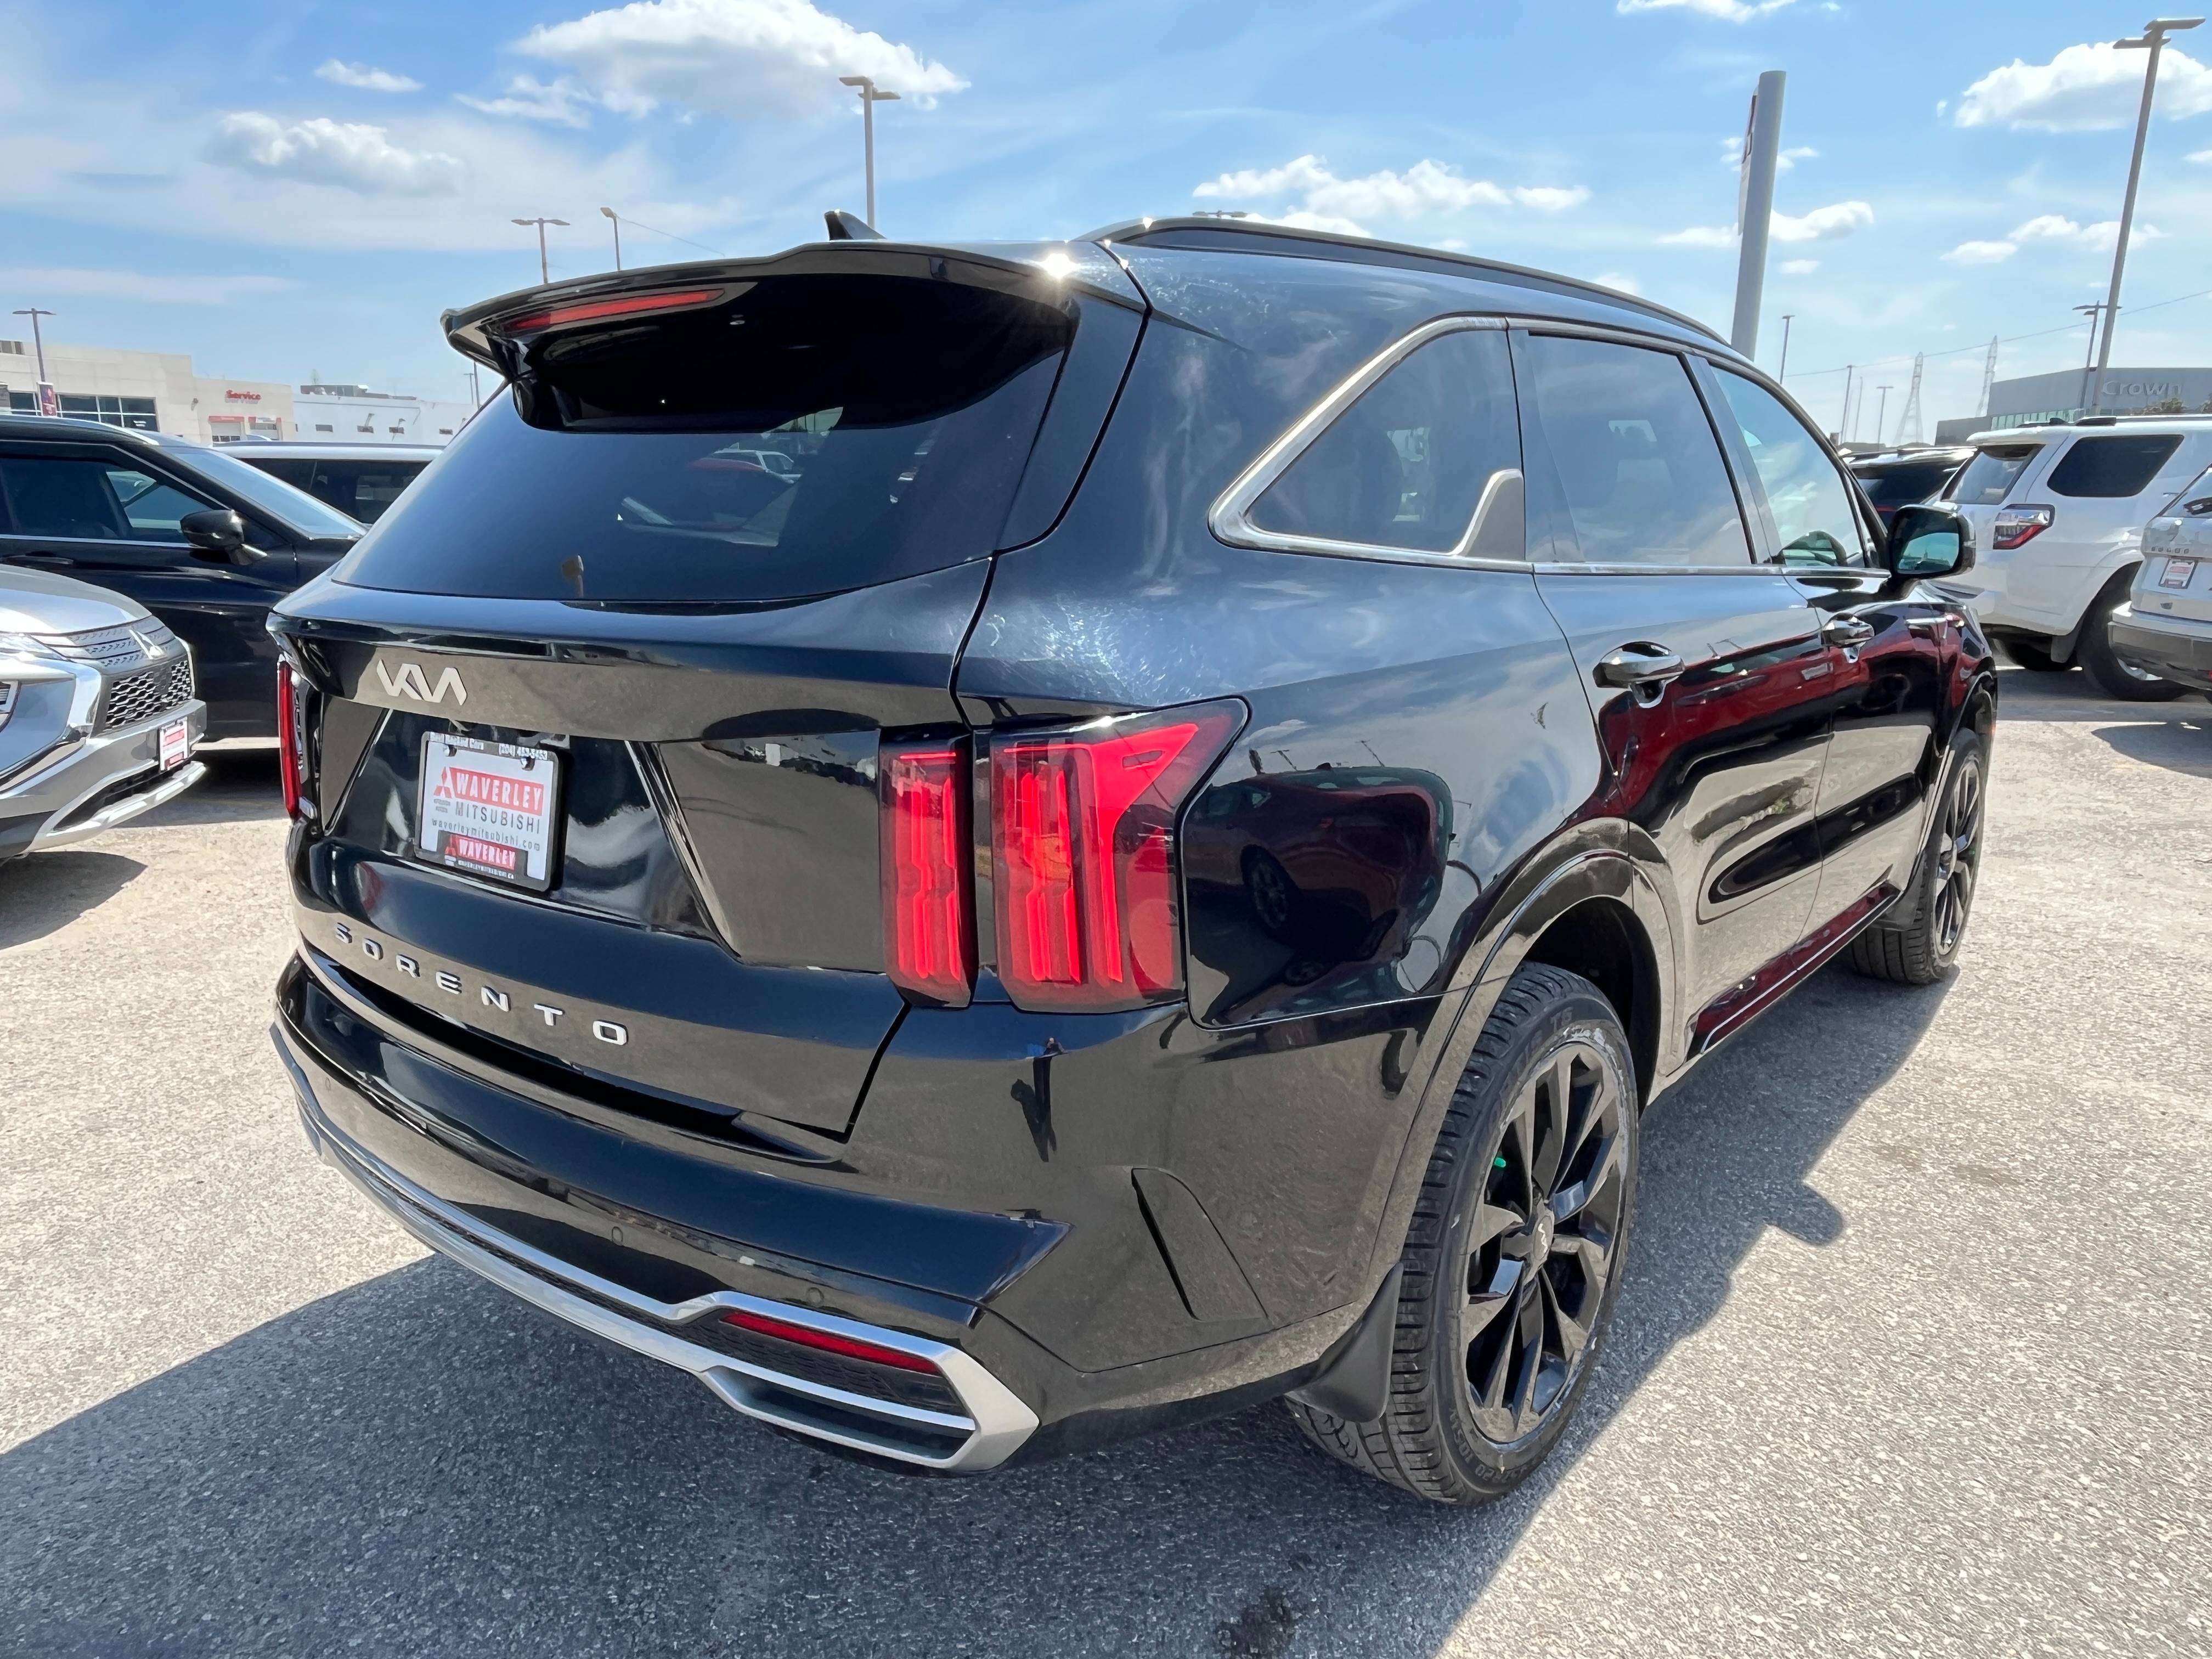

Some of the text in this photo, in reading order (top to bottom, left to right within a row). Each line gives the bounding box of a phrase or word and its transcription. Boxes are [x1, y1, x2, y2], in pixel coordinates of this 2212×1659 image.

[225, 390, 262, 400] Service
[2102, 381, 2182, 396] Crown
[456, 772, 543, 811] WAVERLEY
[455, 800, 540, 834] MITSUBISHI
[458, 838, 516, 867] WAVERLEY
[335, 922, 628, 1046] SORENTO
